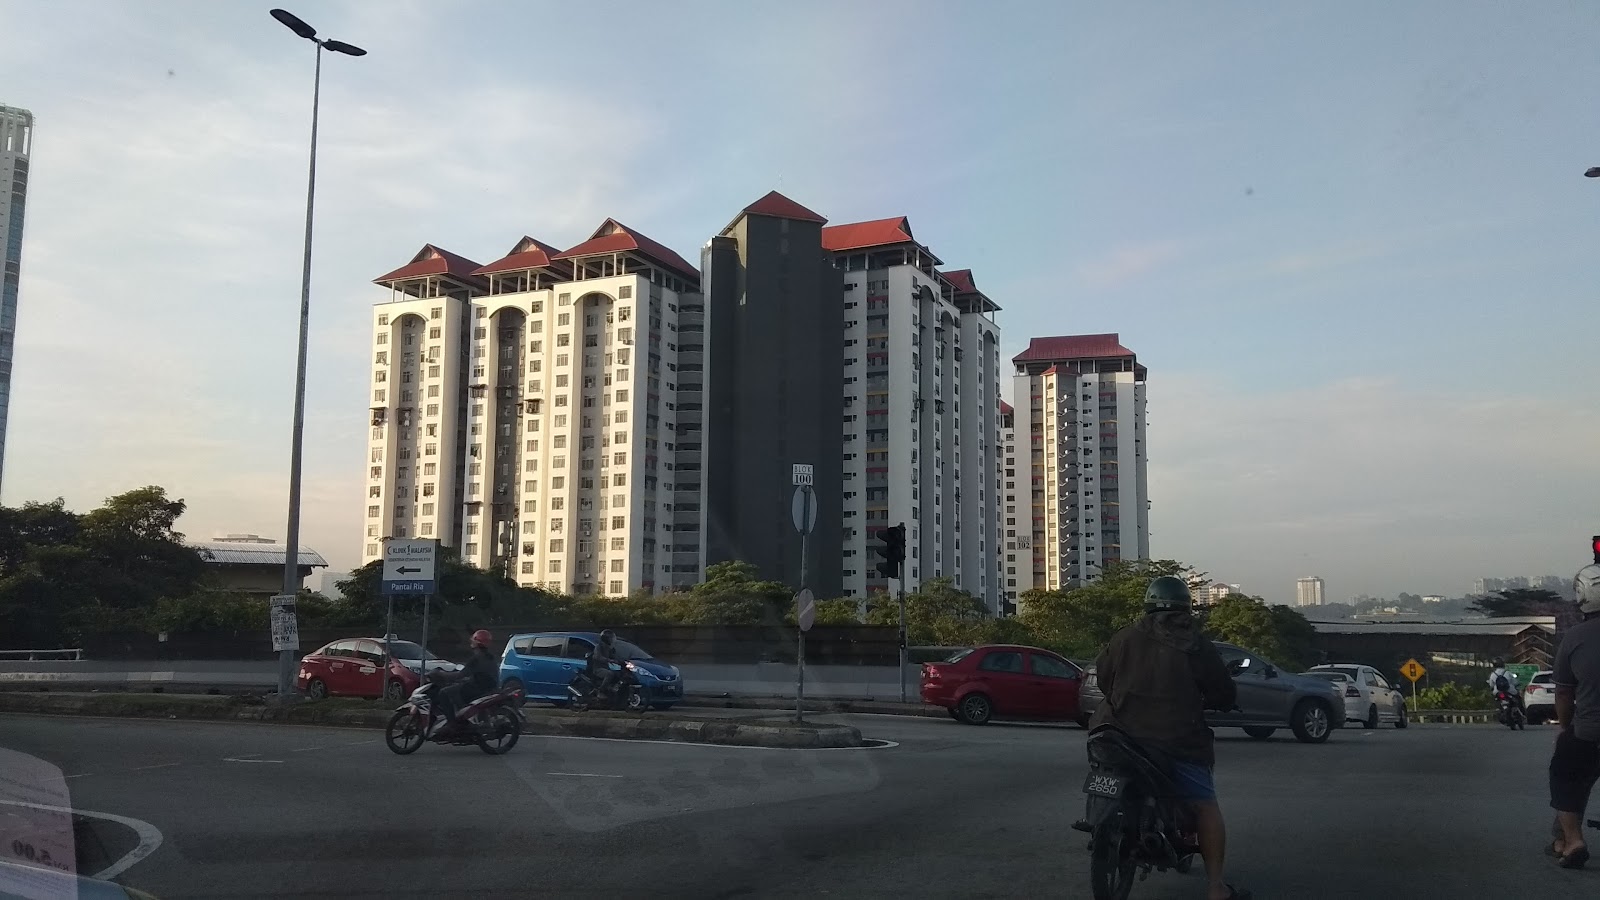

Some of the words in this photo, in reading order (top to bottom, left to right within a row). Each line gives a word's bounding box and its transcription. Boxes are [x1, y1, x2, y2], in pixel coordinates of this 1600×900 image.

[794, 465, 812, 473] BLOK
[794, 474, 812, 484] 100
[391, 582, 412, 590] Pantai
[413, 582, 424, 590] Ria
[1094, 775, 1117, 786] WXW
[1088, 782, 1117, 795] 2650
